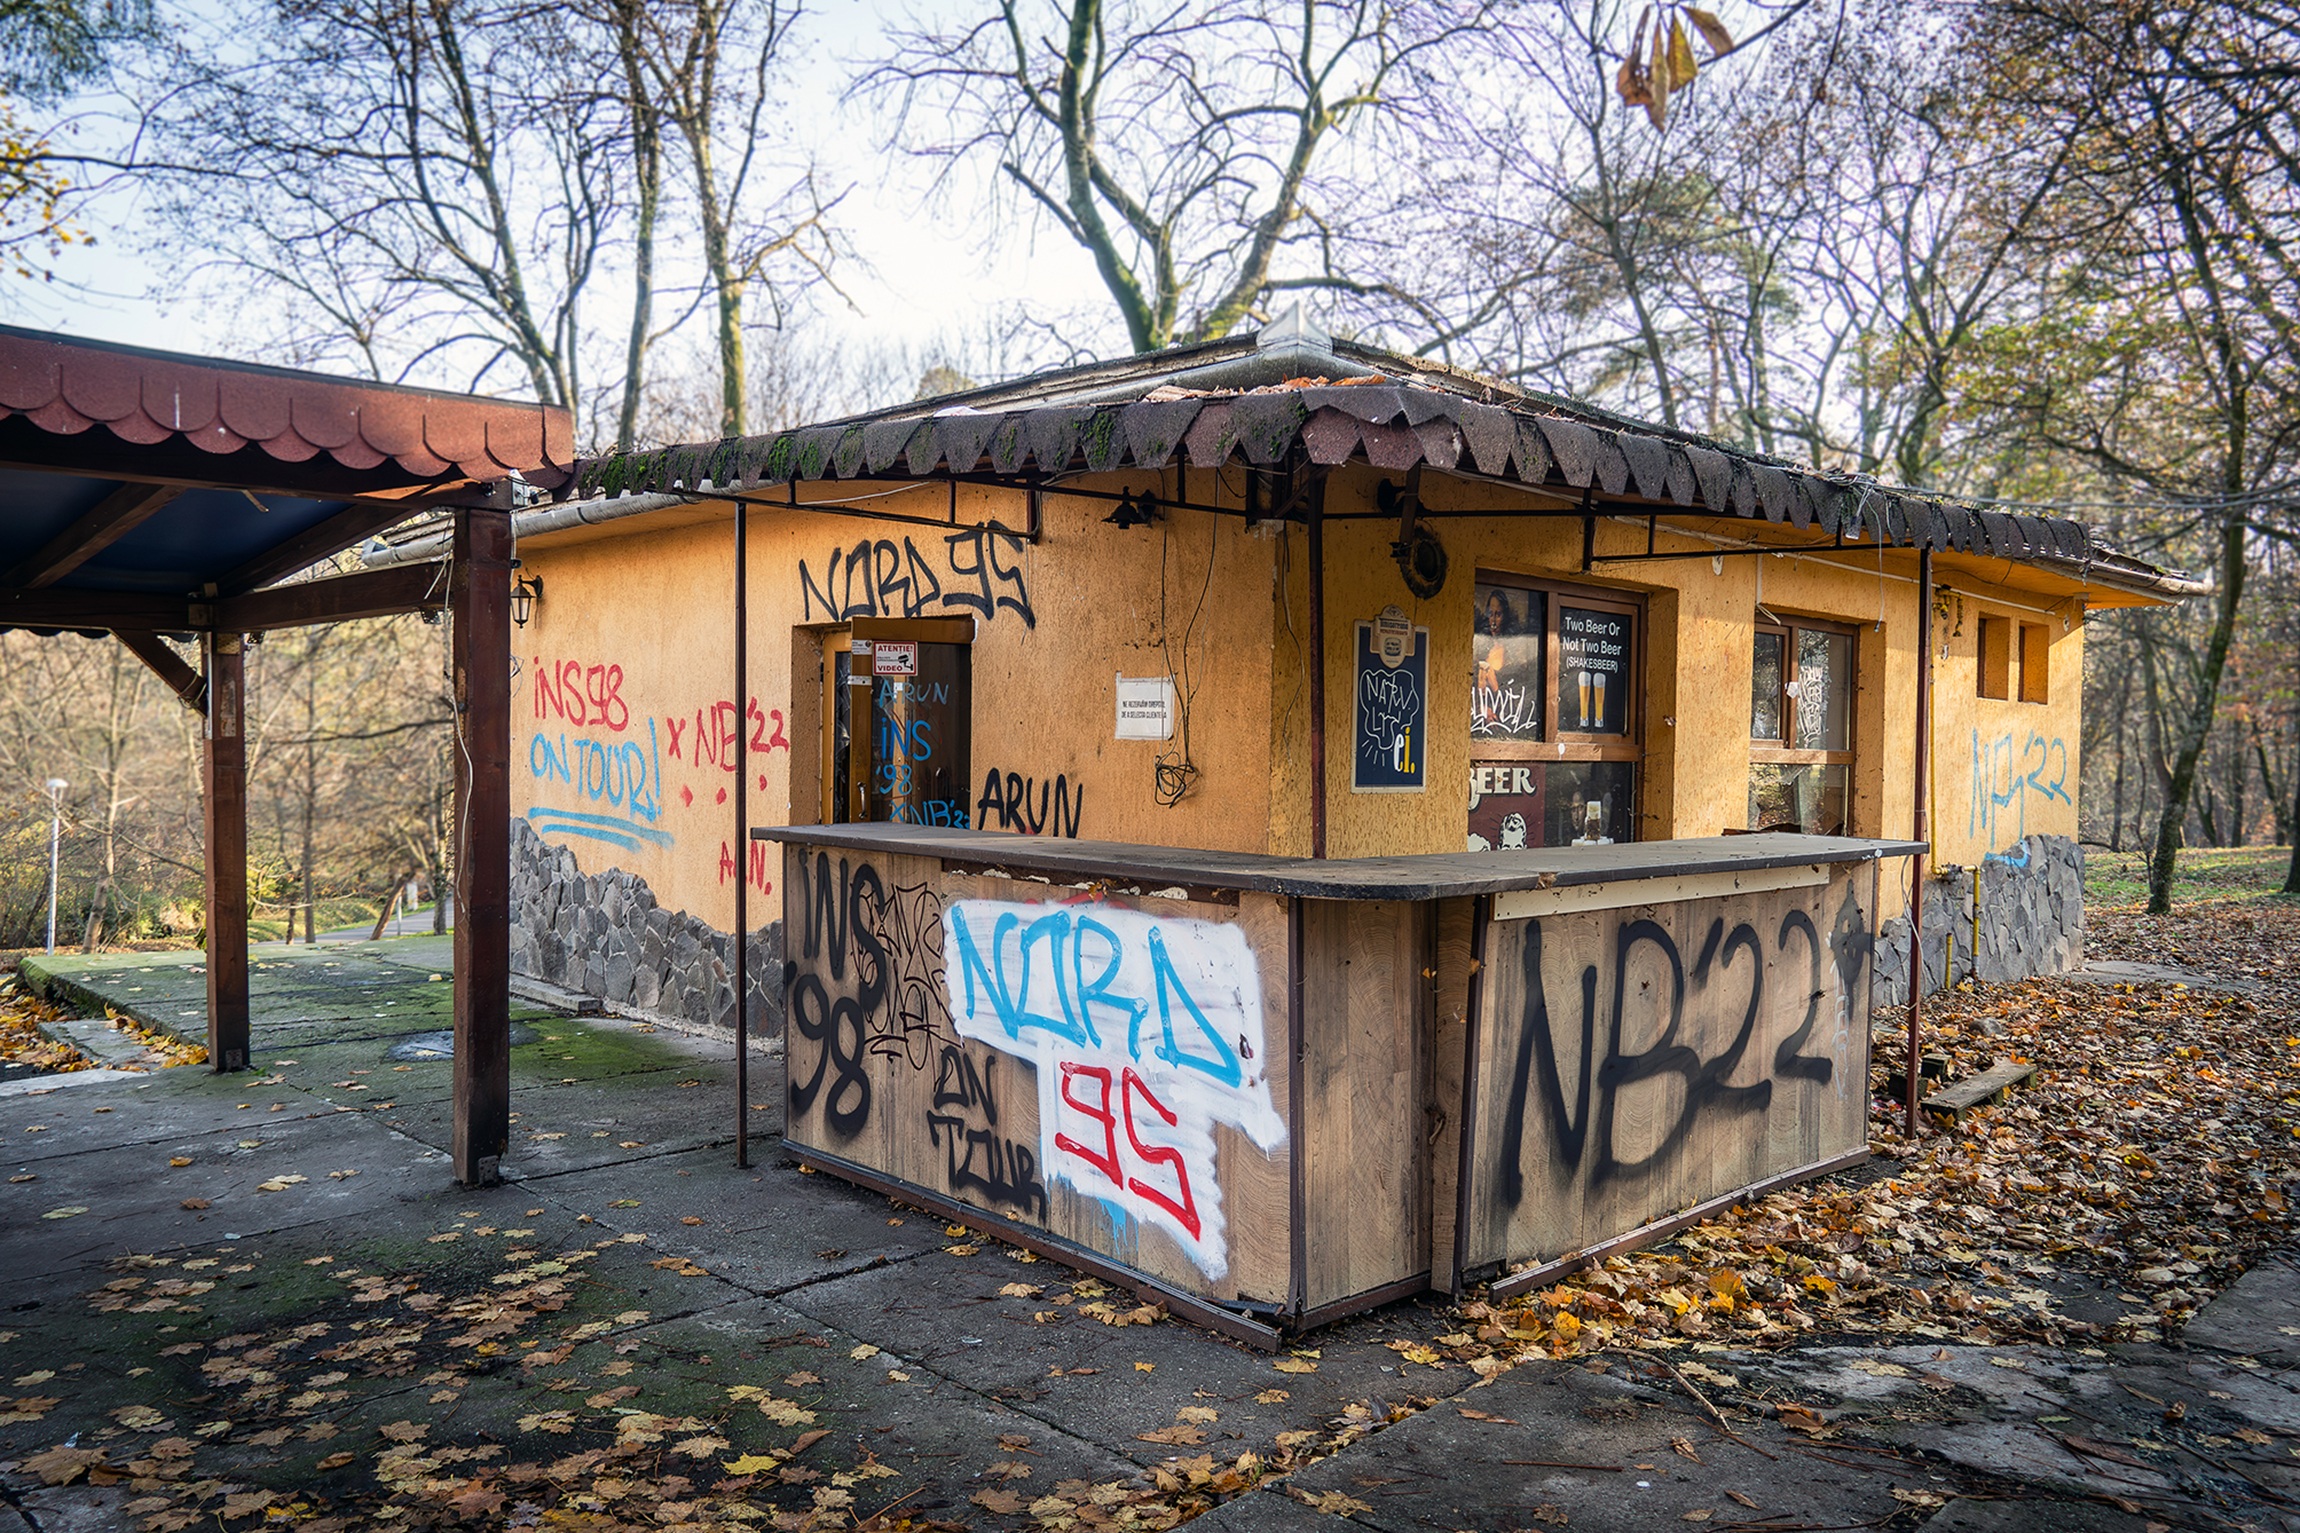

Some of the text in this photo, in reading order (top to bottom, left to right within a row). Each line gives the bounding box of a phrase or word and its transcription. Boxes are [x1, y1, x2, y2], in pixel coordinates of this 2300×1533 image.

[798, 535, 941, 622] NORD
[1562, 637, 1622, 655] Not Two Beer
[1565, 616, 1620, 636] Two Beer Or
[879, 680, 949, 708] ARUN
[1566, 656, 1618, 673] (SHAKESBEER)
[530, 733, 571, 784] ON
[977, 767, 1083, 838] ARUN
[951, 905, 1243, 1089] NORD
[933, 1045, 996, 1126] ON
[927, 1110, 1047, 1224] TOUR
